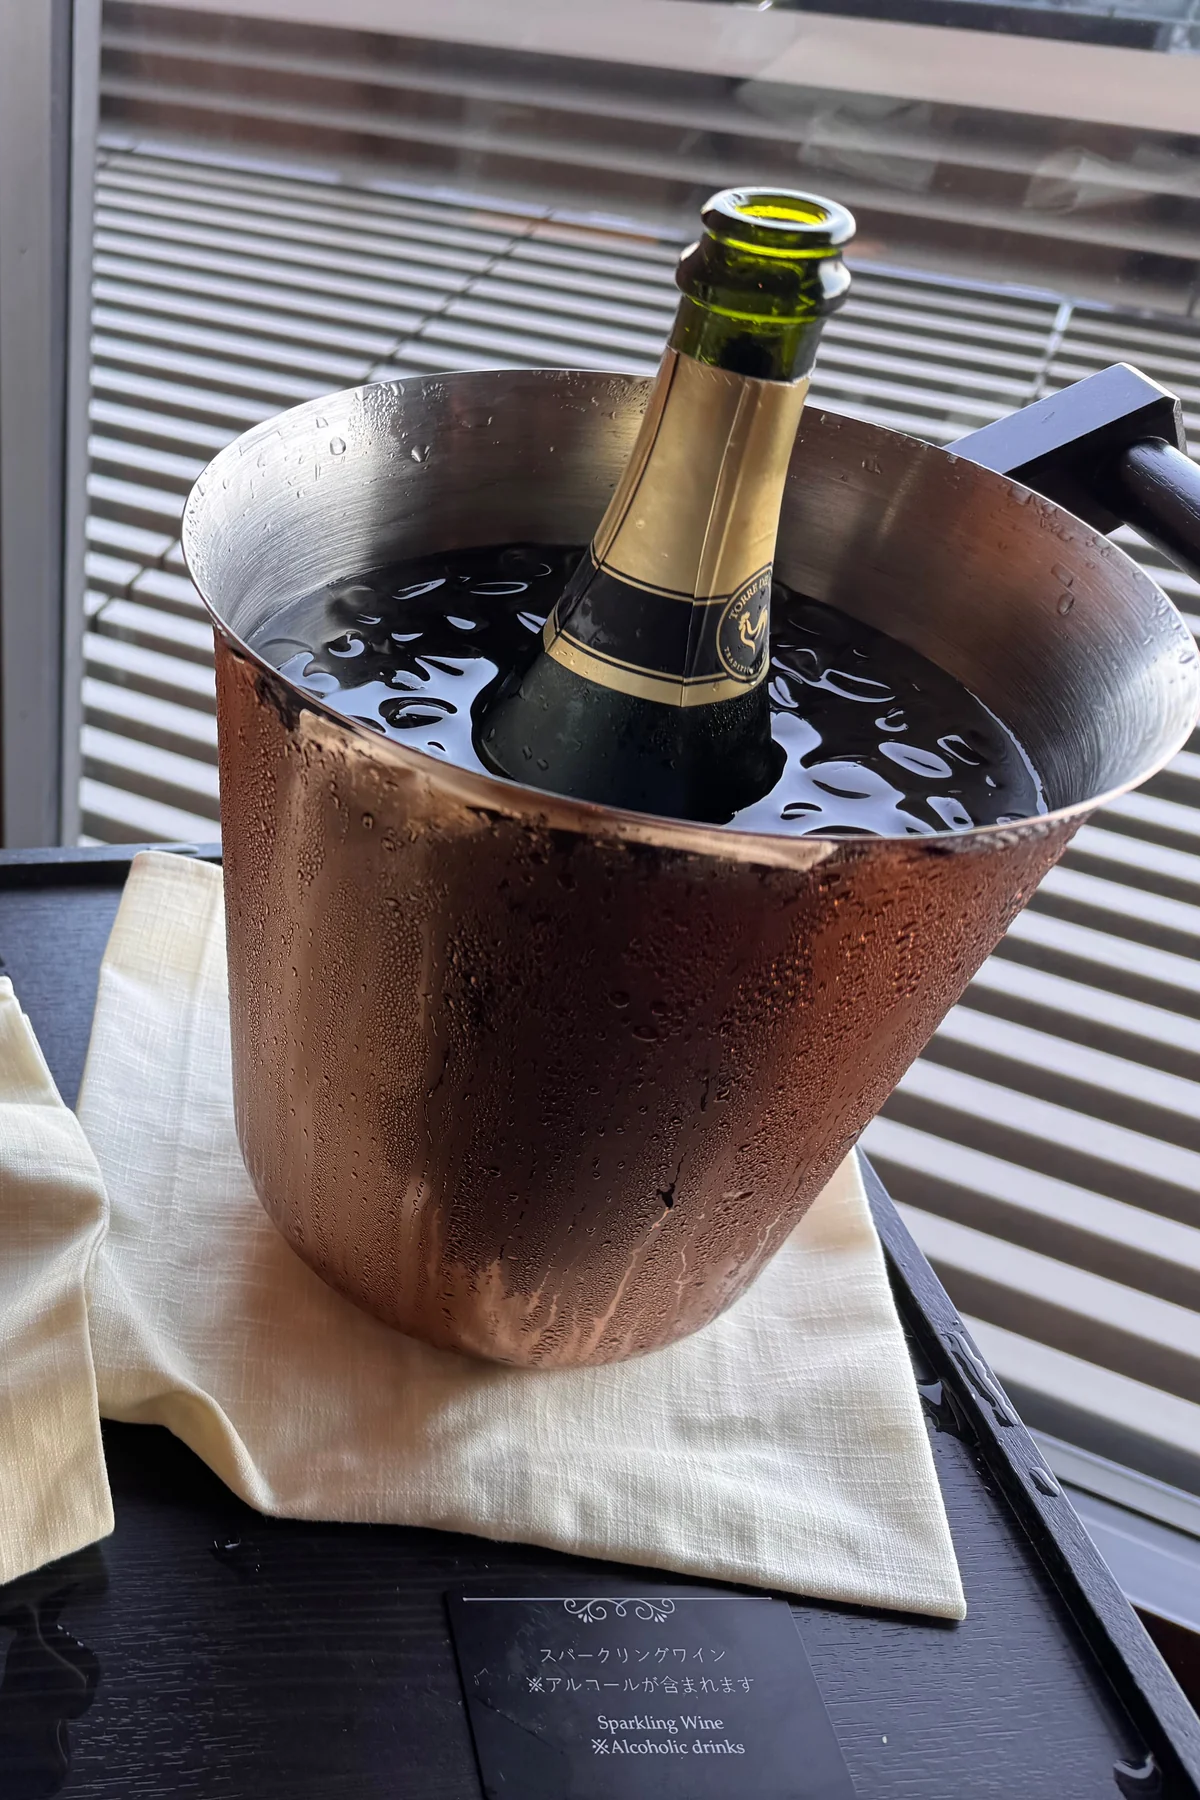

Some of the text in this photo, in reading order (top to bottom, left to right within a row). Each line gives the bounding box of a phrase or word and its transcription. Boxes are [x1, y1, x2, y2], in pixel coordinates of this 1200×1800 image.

[728, 582, 758, 620] TORRE
[540, 1647, 726, 1664] スパークリングワイン
[597, 1714, 724, 1734] Sparkling Wine
[692, 1739, 746, 1755] drinks
